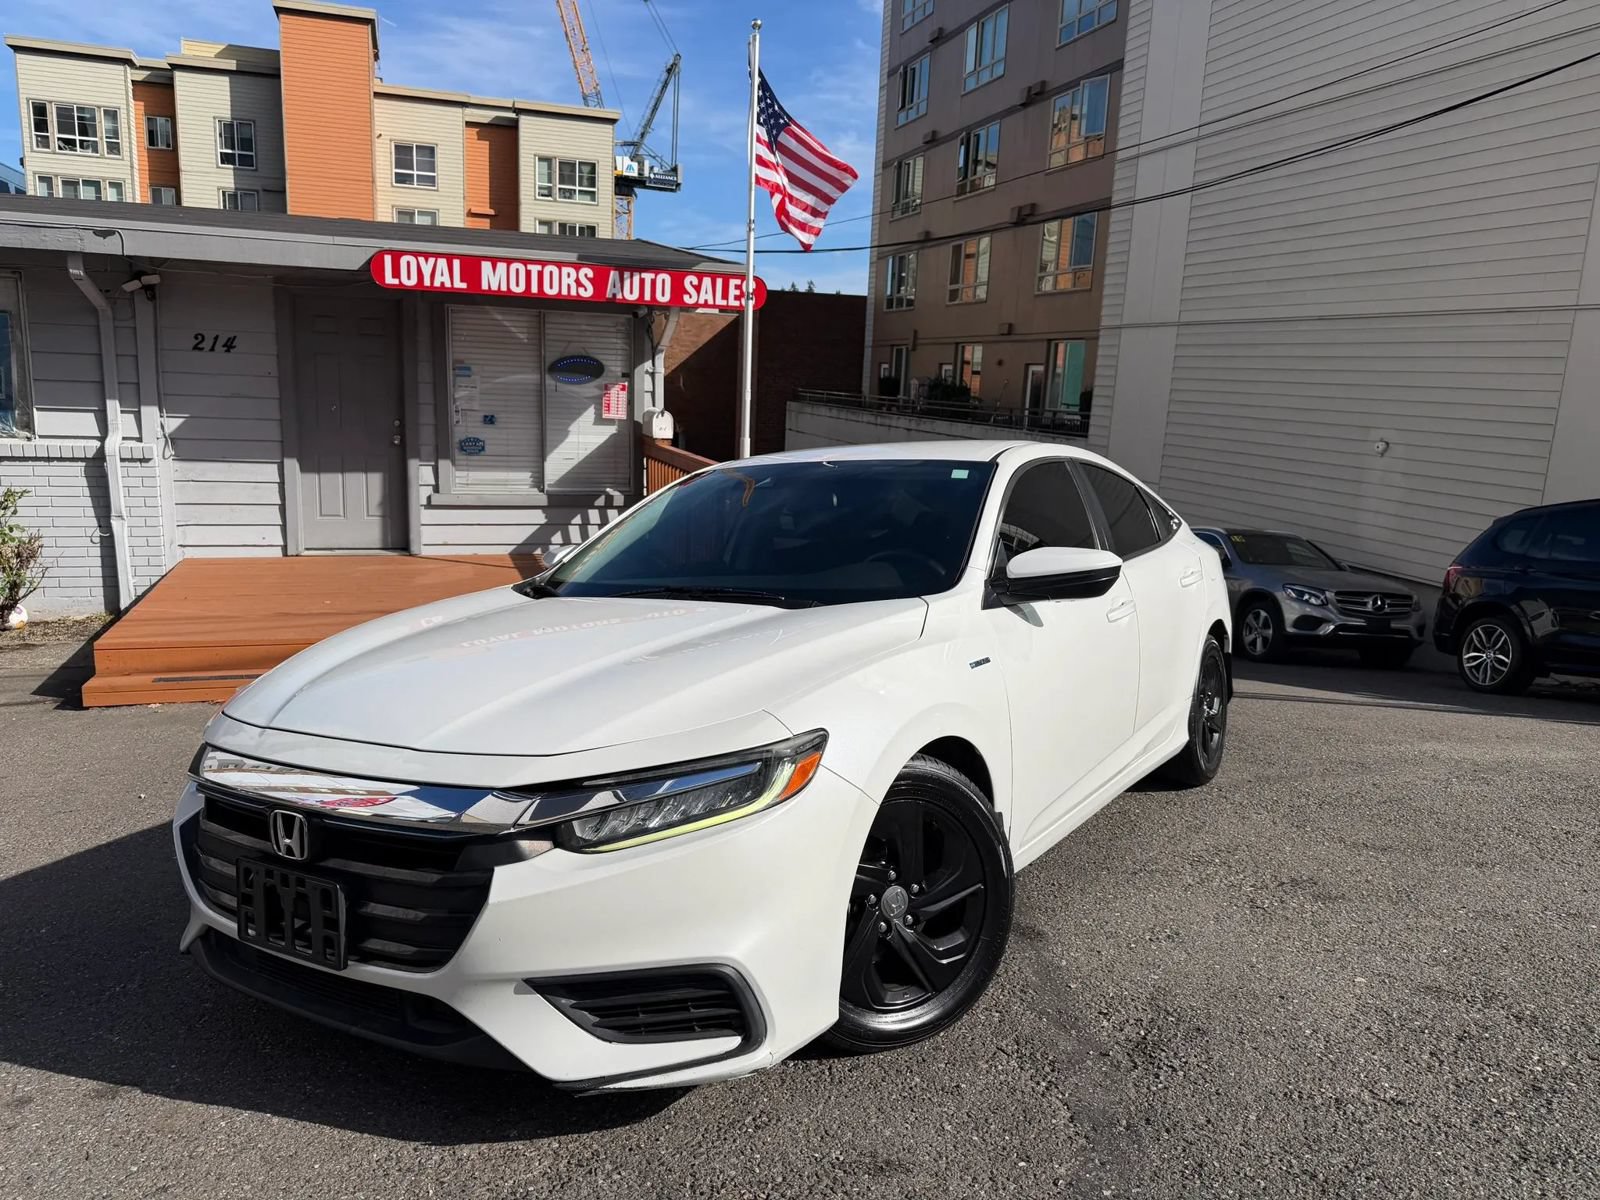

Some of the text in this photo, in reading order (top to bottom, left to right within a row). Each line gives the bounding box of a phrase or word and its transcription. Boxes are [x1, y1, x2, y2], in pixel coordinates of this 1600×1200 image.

[384, 254, 467, 289] LOYAL
[480, 261, 594, 298] MOTORS
[606, 270, 671, 303] AUTO
[192, 333, 237, 353] 214
